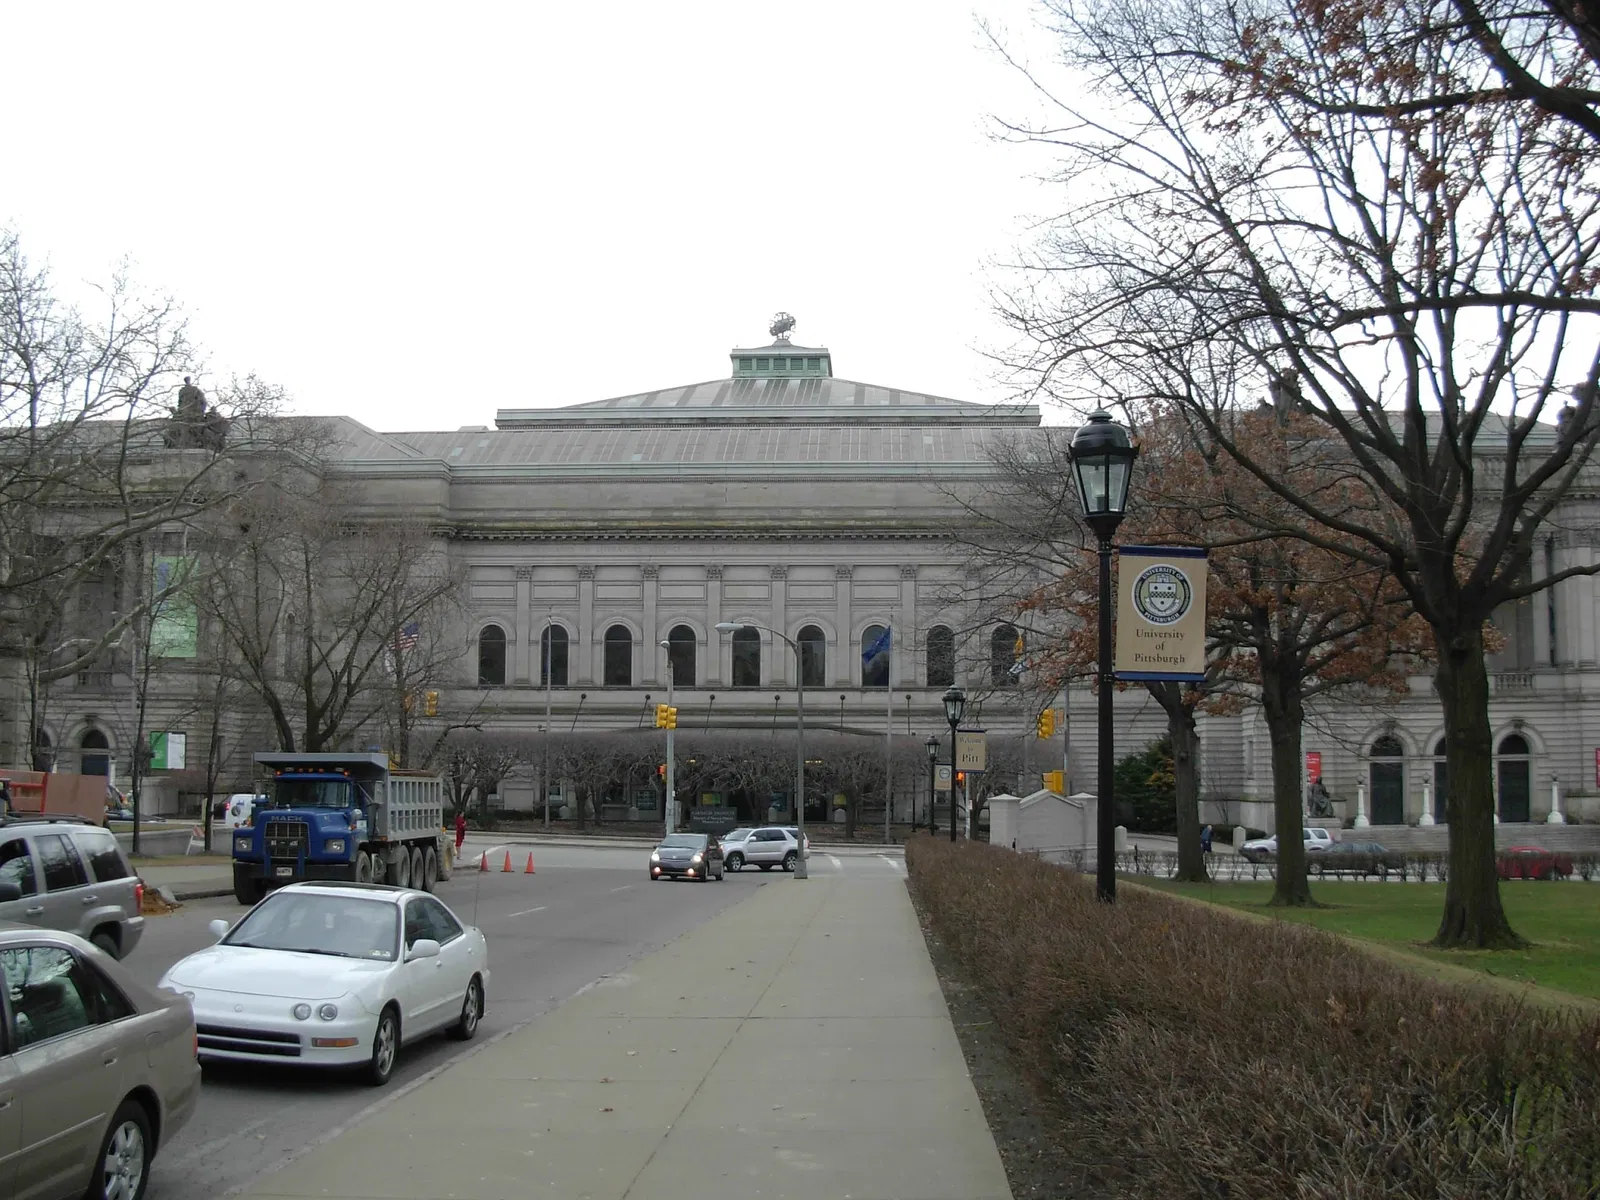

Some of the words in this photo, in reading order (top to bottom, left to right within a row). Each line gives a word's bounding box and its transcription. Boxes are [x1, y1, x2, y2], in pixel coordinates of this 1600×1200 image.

[1142, 567, 1176, 580] UNIVERSITY
[1144, 612, 1180, 622] PITTSBURGH
[1136, 628, 1185, 640] University
[1155, 641, 1165, 650] of
[1134, 653, 1185, 665] Pittsburgh
[962, 754, 979, 762] Pitt
